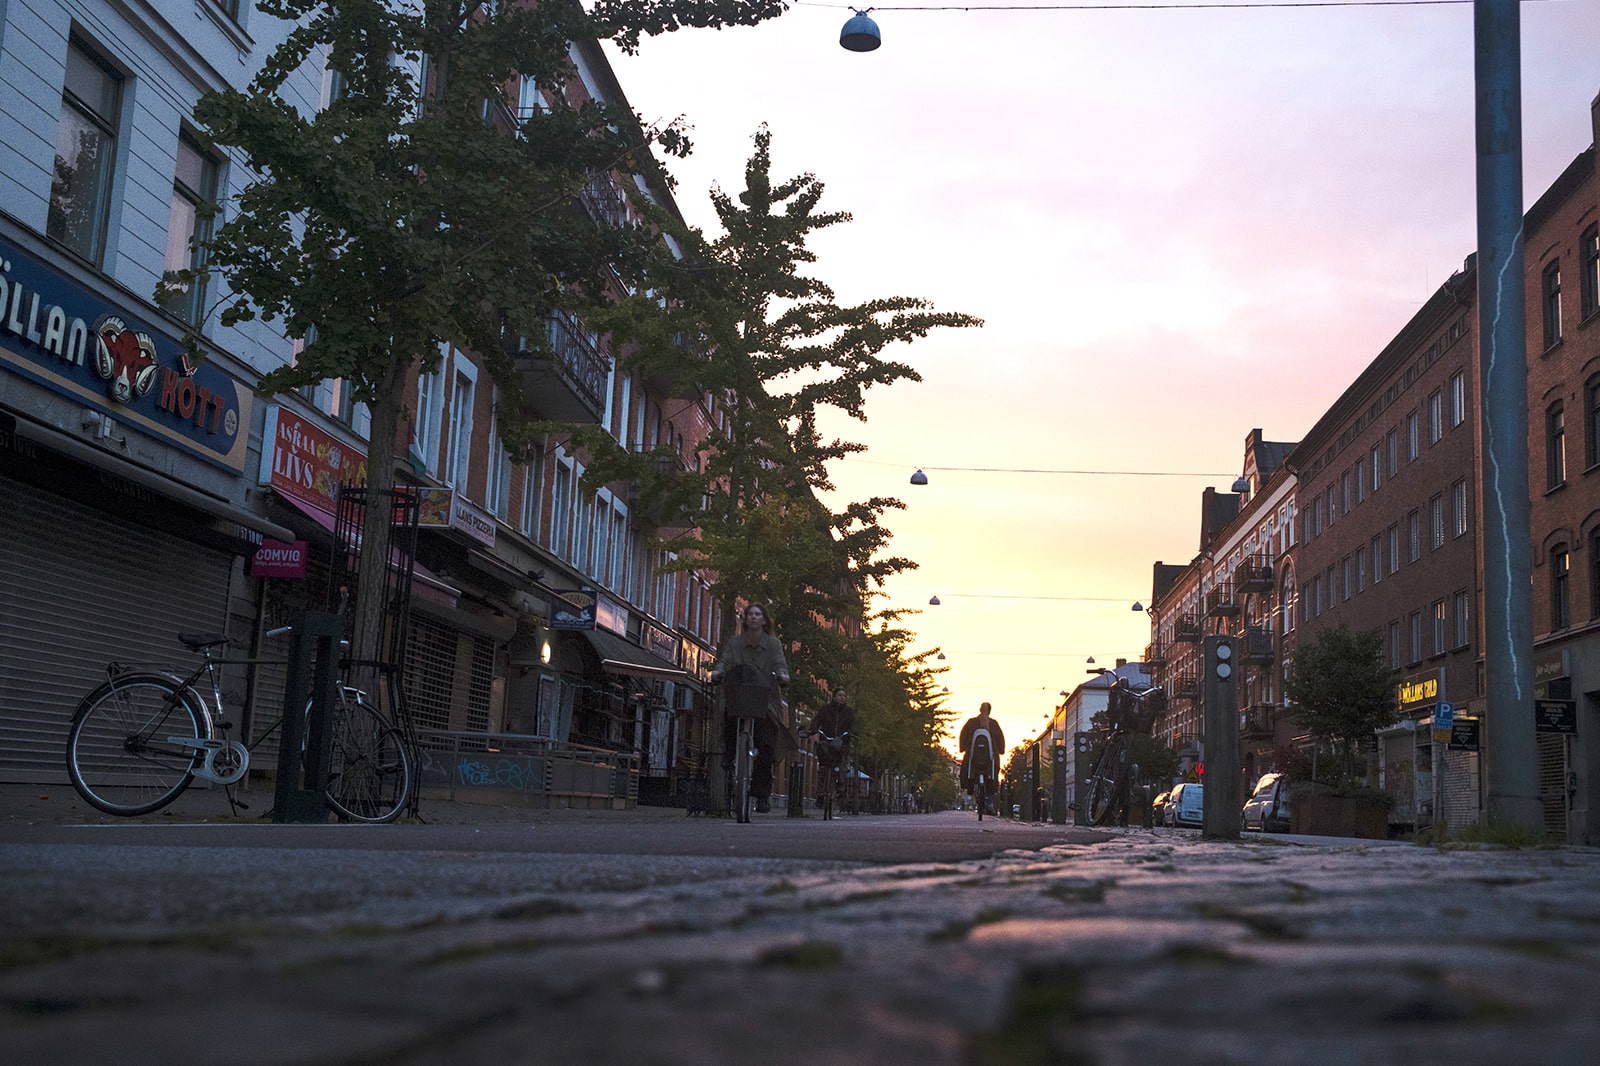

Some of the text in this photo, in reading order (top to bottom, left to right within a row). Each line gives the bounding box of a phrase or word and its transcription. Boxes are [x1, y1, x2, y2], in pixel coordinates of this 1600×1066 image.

[274, 445, 314, 489] LIVS
[255, 549, 301, 562] COMVIQ
[1439, 703, 1451, 718] P
